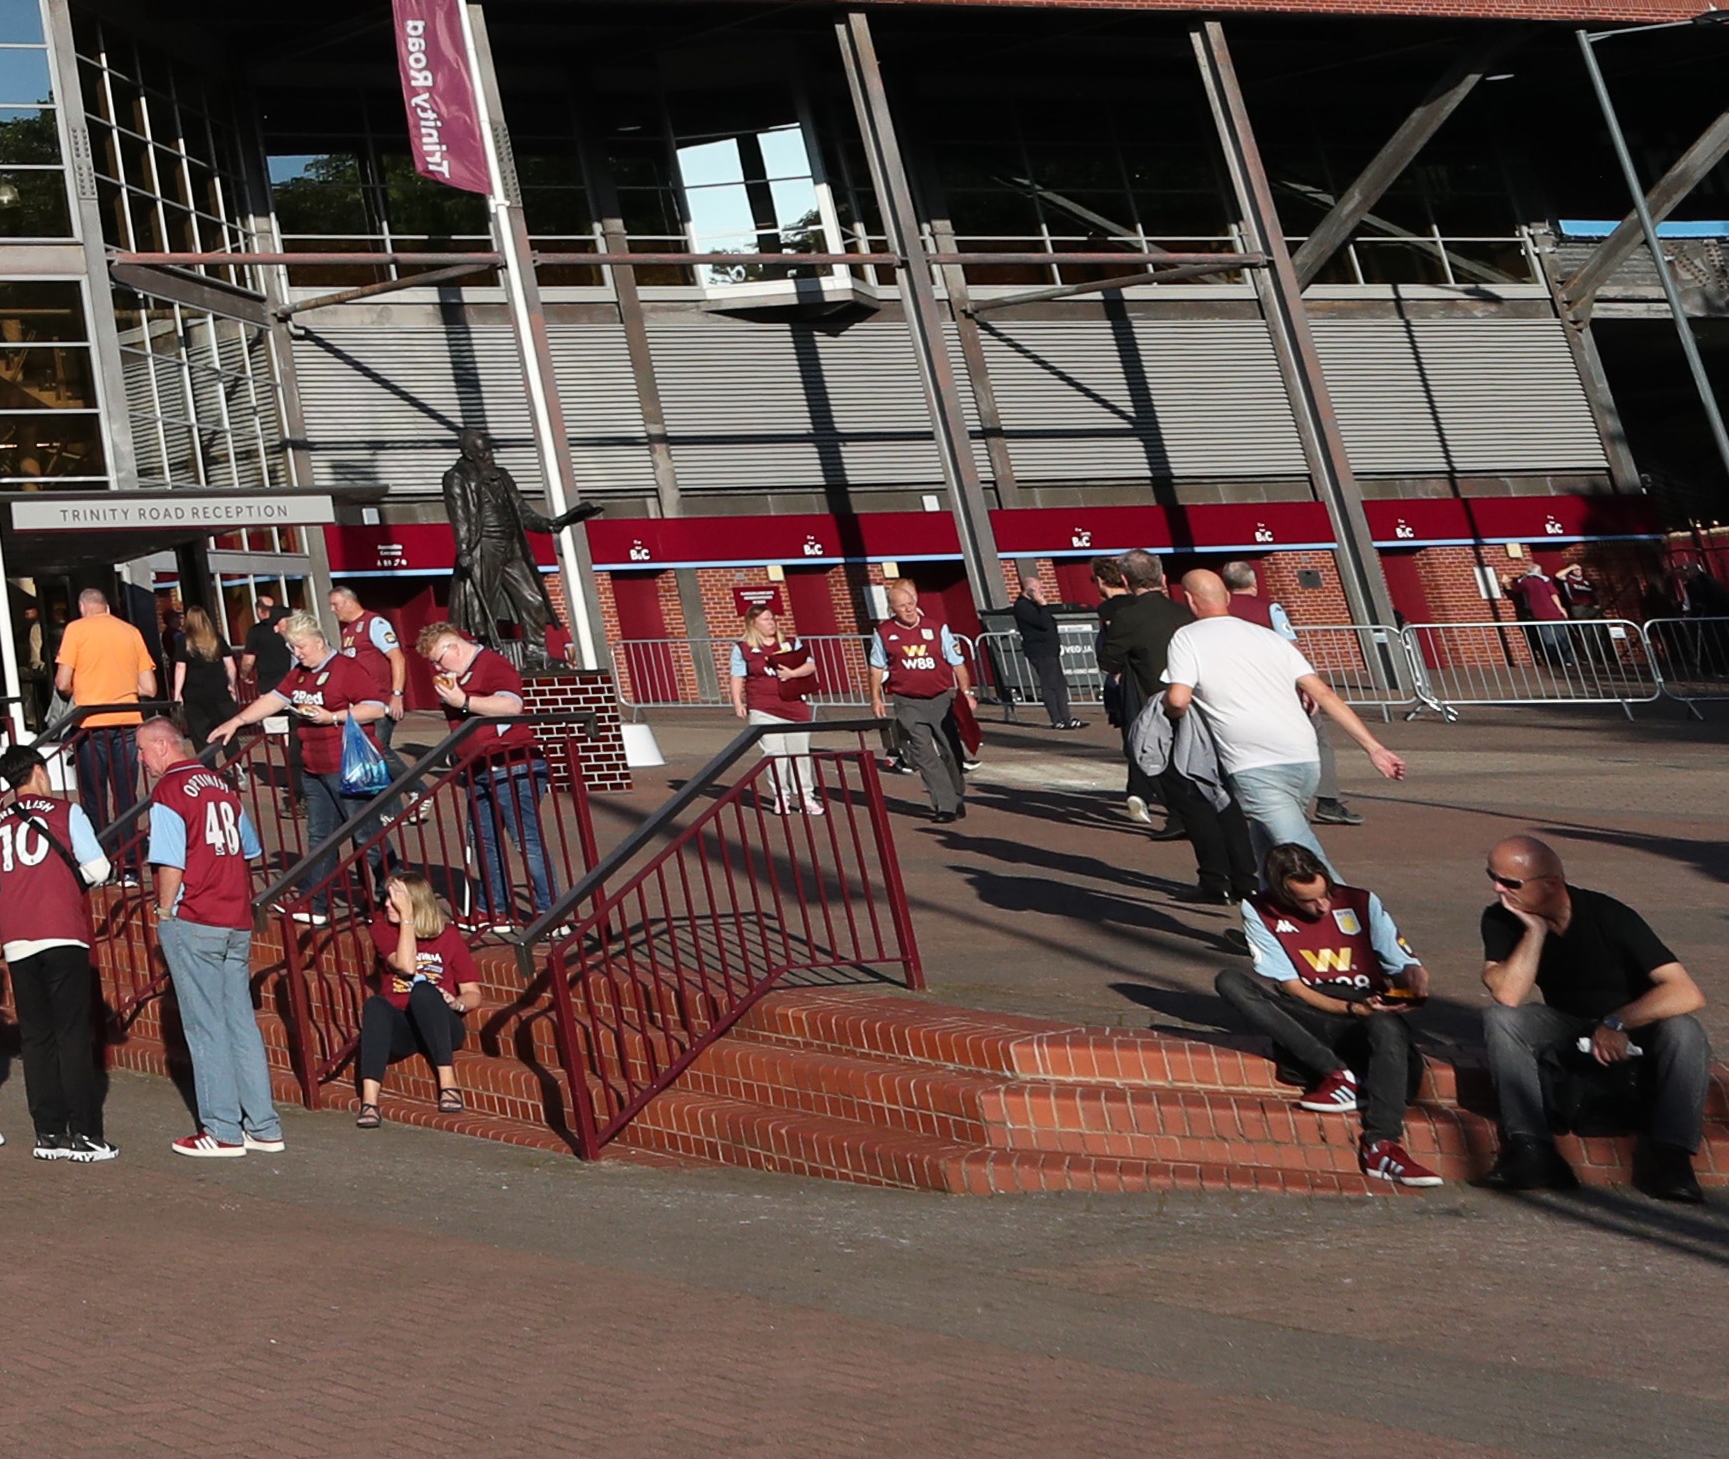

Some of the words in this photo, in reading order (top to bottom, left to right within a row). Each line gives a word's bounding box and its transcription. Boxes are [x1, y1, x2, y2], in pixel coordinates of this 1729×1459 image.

[60, 508, 129, 522] TRINITY
[138, 507, 185, 521] ROAD
[192, 505, 288, 520] RECEPTION
[902, 657, 935, 670] W88
[292, 690, 324, 705] 2Red
[206, 801, 239, 856] 48
